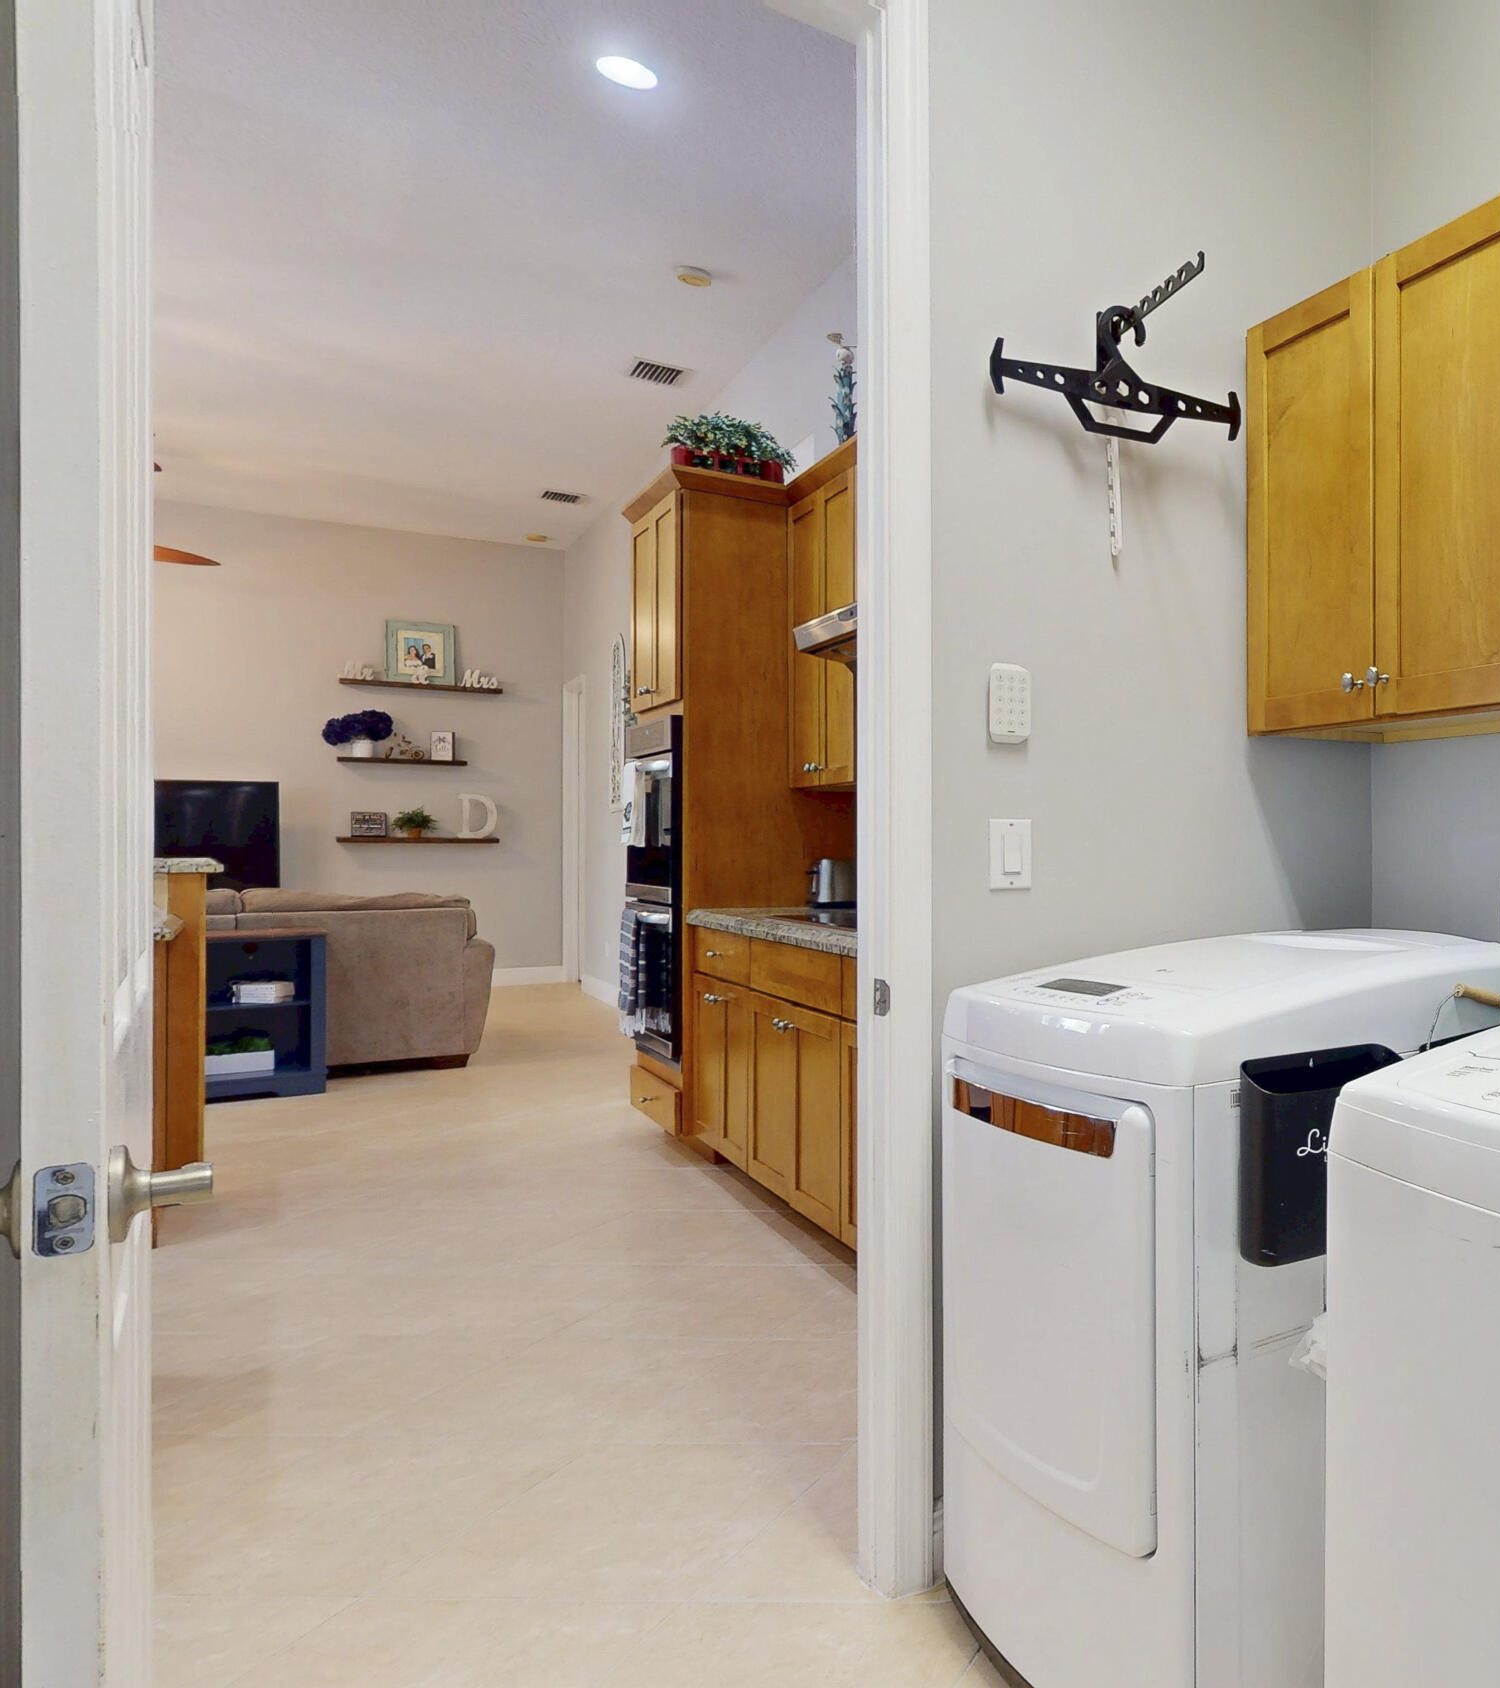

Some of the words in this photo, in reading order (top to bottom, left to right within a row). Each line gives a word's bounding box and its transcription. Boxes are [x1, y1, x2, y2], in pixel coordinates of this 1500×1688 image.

[459, 668, 499, 689] Mrs
[457, 794, 498, 839] D
[1296, 1128, 1328, 1157] Li
